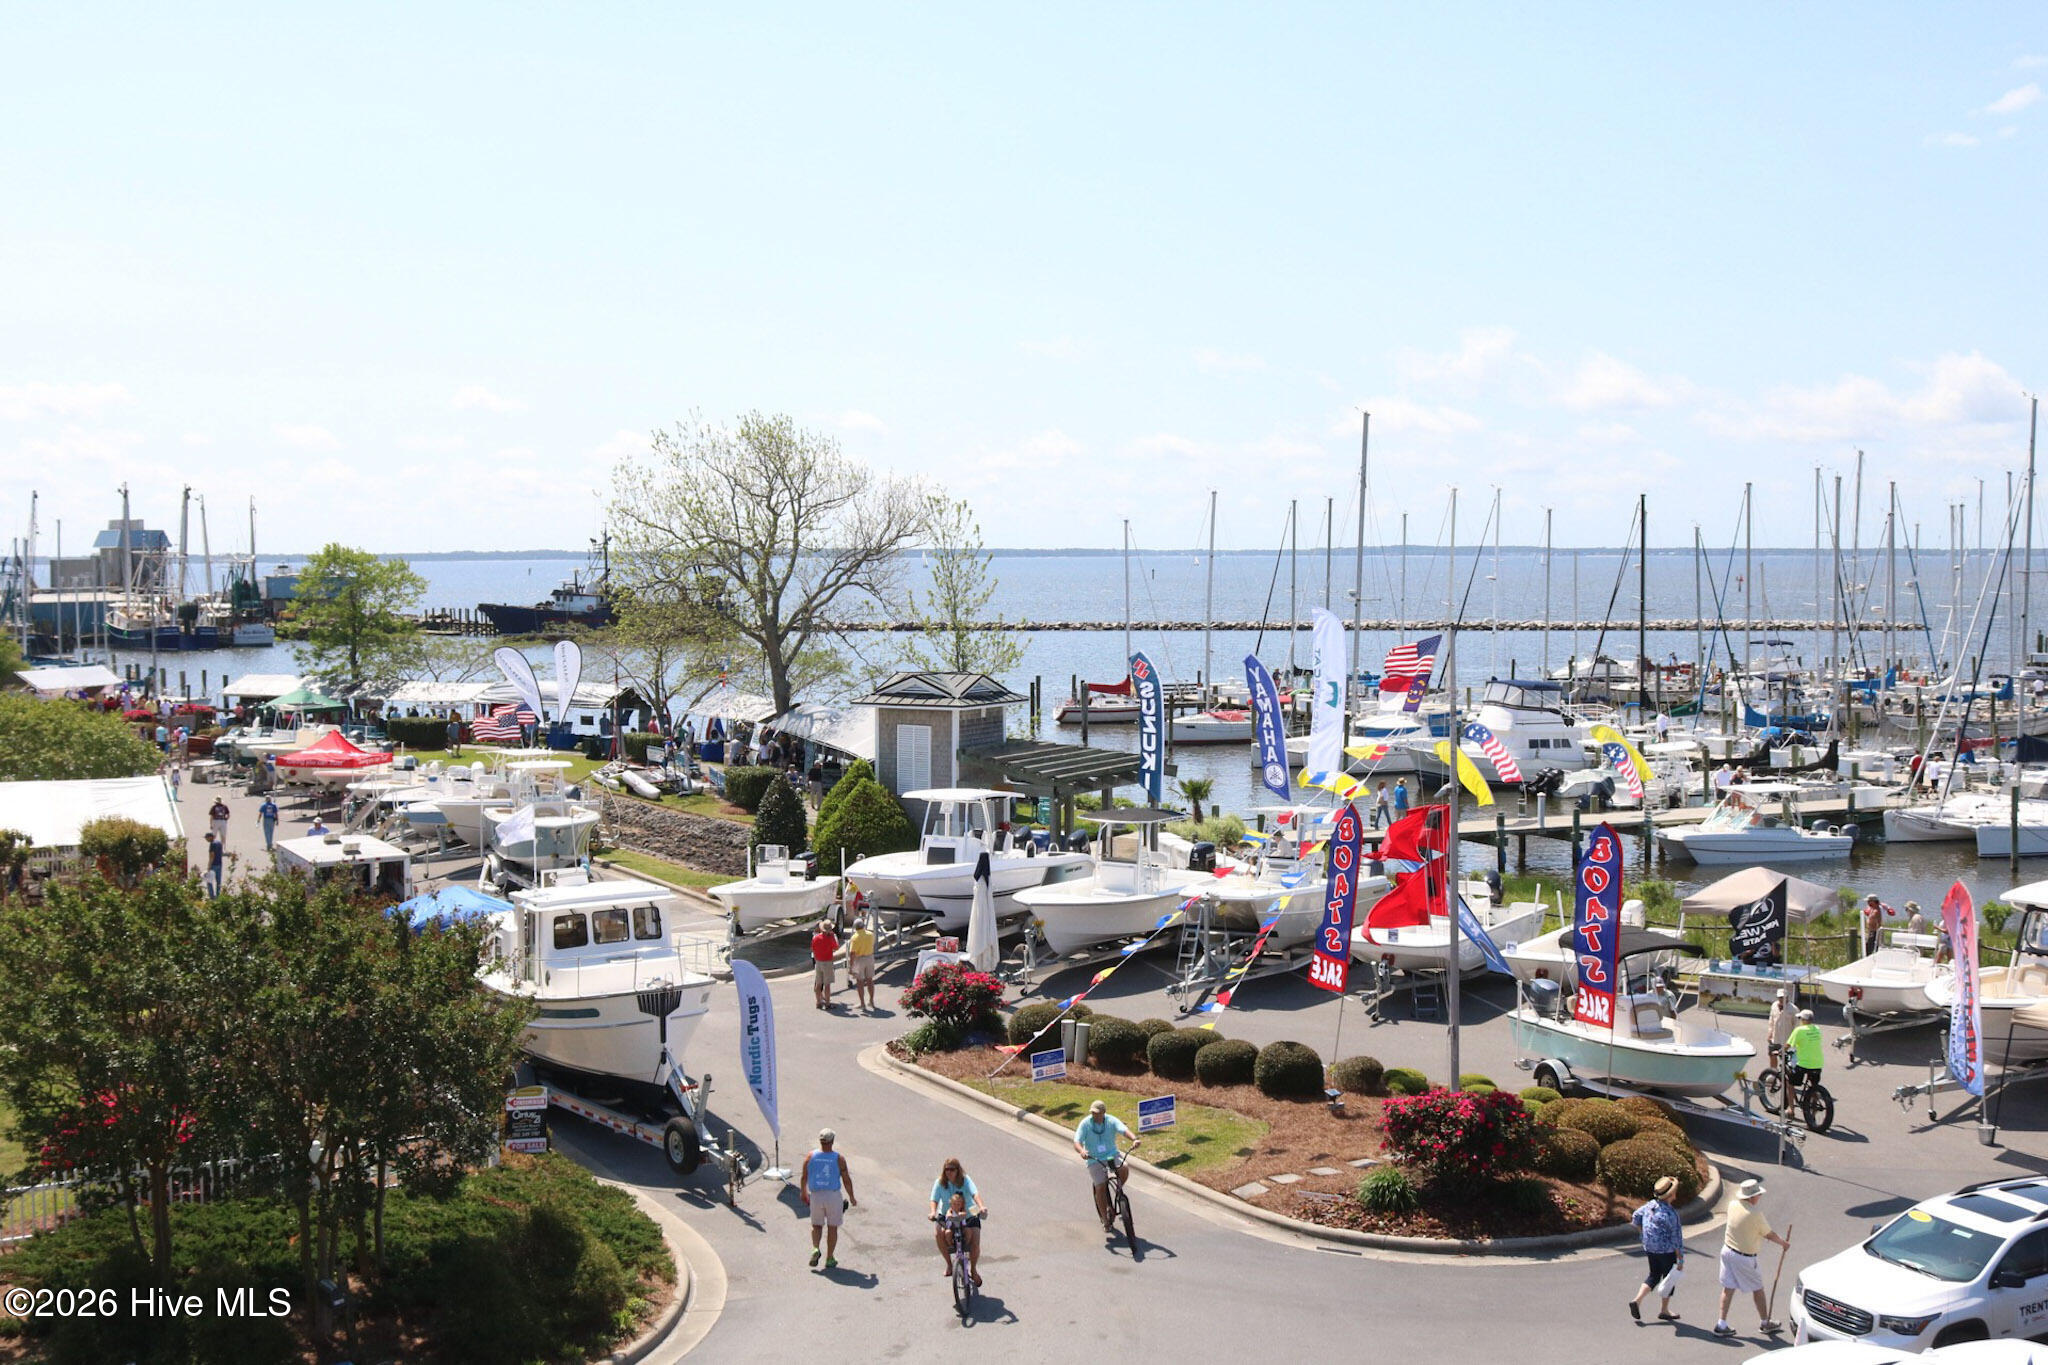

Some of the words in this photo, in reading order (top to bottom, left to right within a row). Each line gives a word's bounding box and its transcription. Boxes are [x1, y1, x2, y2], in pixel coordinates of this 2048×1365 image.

[747, 996, 761, 1036] Tugs
[748, 1036, 763, 1086] Nordic
[2019, 1299, 2048, 1317] TRENT
